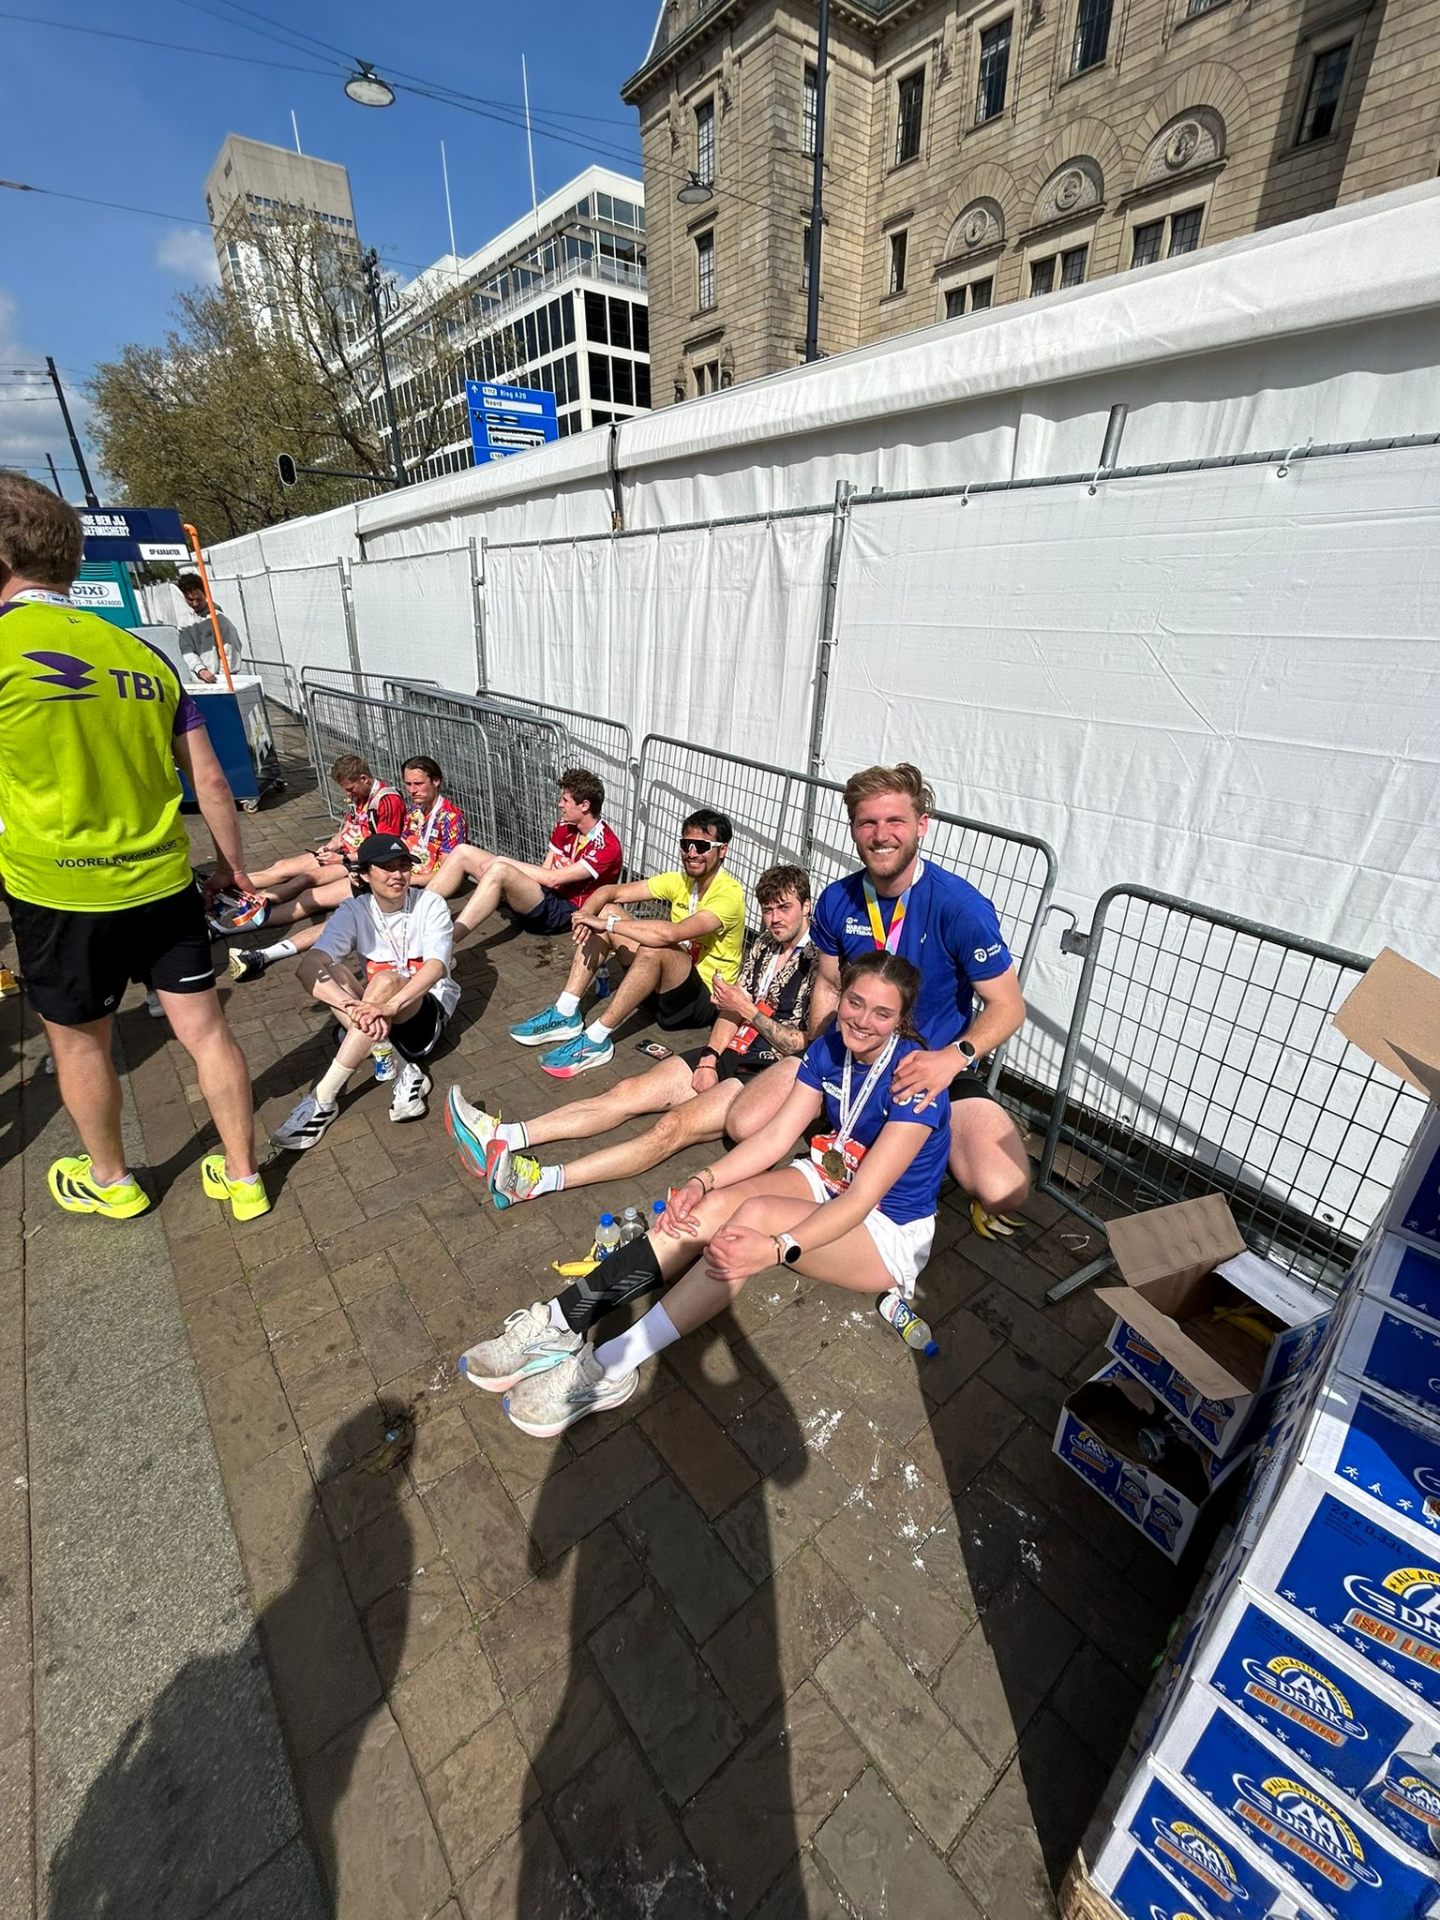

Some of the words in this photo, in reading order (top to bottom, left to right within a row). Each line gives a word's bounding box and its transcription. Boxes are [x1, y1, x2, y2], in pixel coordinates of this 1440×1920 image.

[485, 399, 503, 407] Noord
[500, 389, 513, 399] Ring
[514, 391, 527, 400] A20
[108, 668, 165, 704] TBI
[533, 1016, 568, 1034] BROOKS
[1393, 1570, 1416, 1585] ALL
[1351, 1612, 1398, 1644] ISO
[1400, 1604, 1440, 1640] DR
[1280, 1681, 1344, 1727] DRINK
[1289, 1674, 1336, 1713] AA
[1250, 1684, 1279, 1707] ISO
[1281, 1703, 1341, 1744] LEMON
[1406, 1790, 1440, 1815] DRIN
[1277, 1806, 1352, 1867] DRINK
[1288, 1801, 1345, 1851] AA
[1188, 1838, 1223, 1872] AA
[1240, 1803, 1274, 1831] ISO
[1278, 1830, 1348, 1886] LEMON
[1180, 1840, 1230, 1886] DRINK
